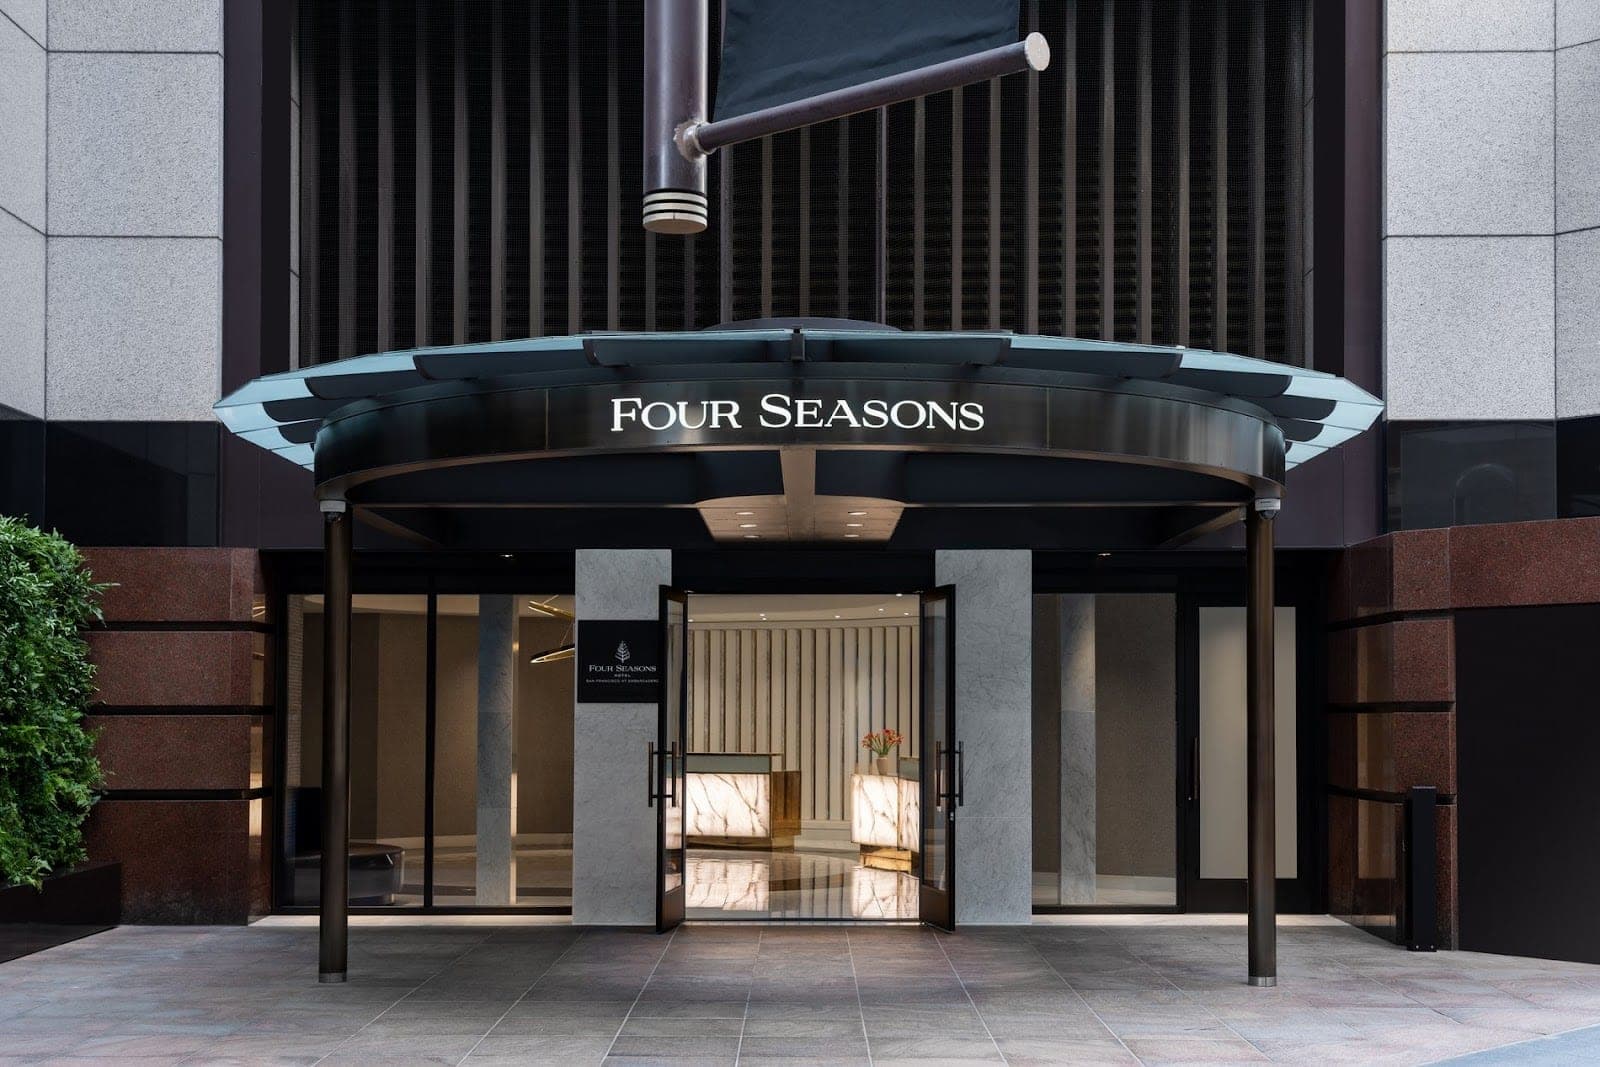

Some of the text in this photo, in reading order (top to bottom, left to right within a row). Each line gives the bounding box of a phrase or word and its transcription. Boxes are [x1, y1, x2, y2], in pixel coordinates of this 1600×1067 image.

[610, 393, 985, 432] FOUR SEASONS
[588, 664, 657, 673] FOUR SEASONS
